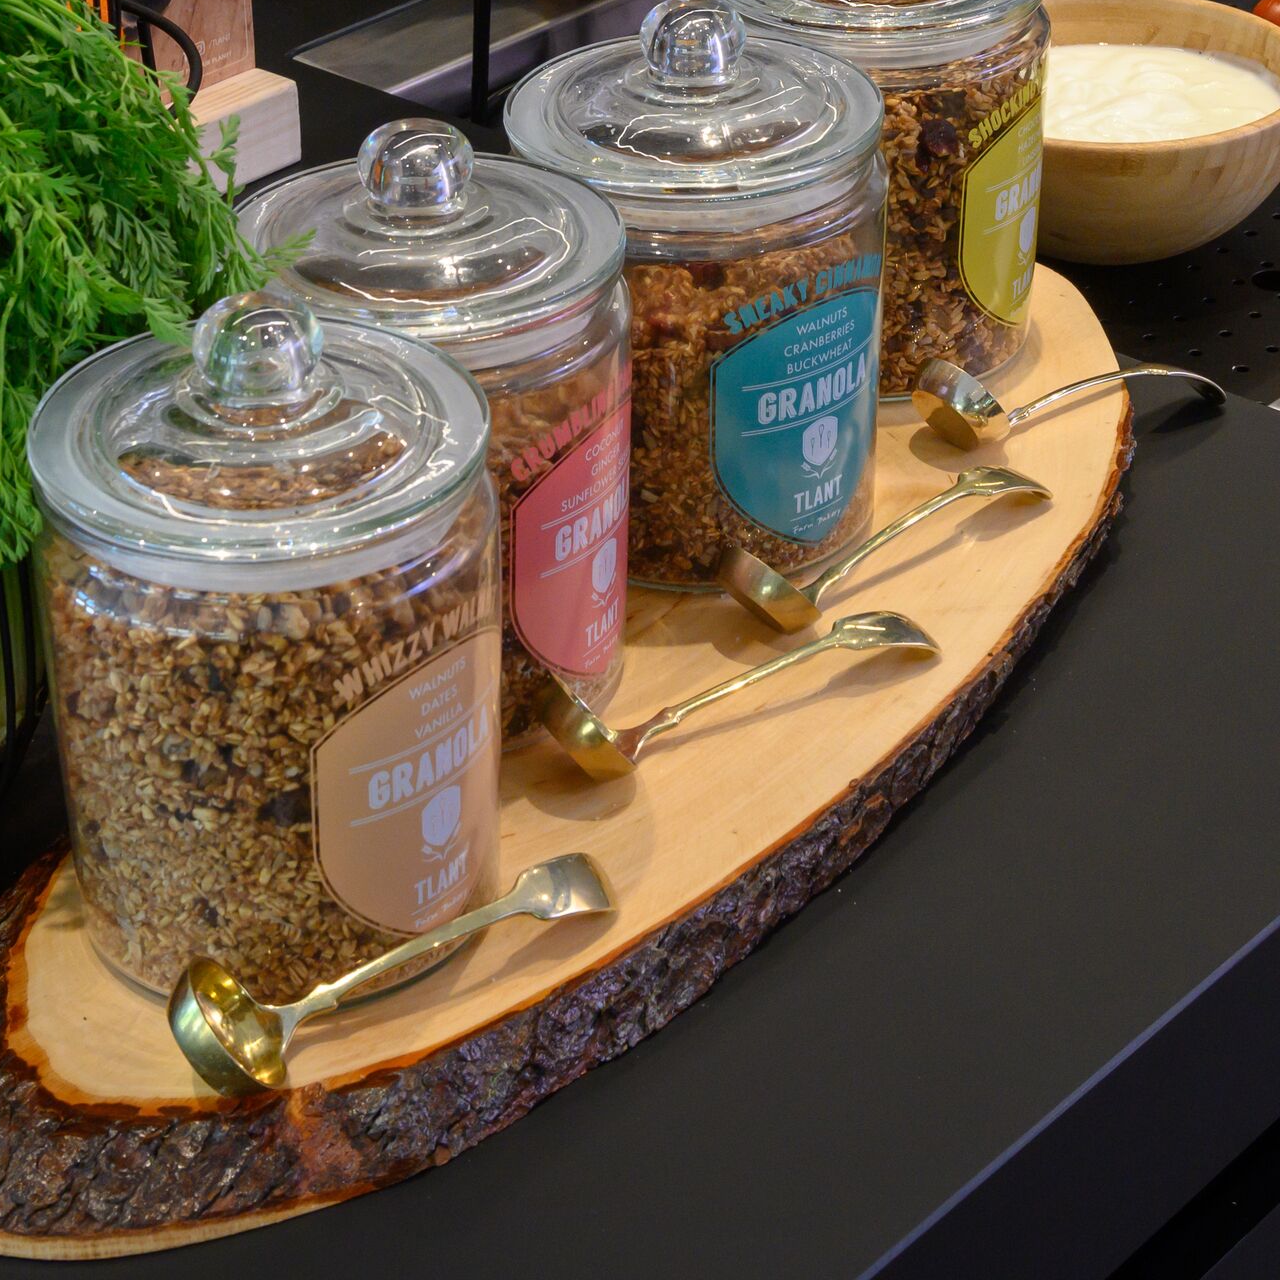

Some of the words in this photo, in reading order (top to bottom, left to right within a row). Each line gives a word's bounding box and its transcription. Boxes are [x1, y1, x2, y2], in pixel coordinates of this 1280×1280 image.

[723, 276, 809, 335] SNEAKY
[796, 306, 848, 336] WALNUTS
[784, 320, 855, 358] CRANBERRIES
[787, 338, 853, 375] BUCKWHEAT
[757, 352, 867, 425] GRANOLA
[561, 468, 618, 513] SUNFLOWER
[794, 474, 843, 514] TLANT
[555, 480, 628, 561] GRANOL
[585, 598, 620, 648] TLANT
[332, 620, 436, 701] WHIZZY
[409, 656, 467, 700] WALNUTS
[414, 702, 464, 739] VANILLA
[421, 684, 458, 717] DATES
[367, 704, 490, 810] GRANOLA
[414, 847, 470, 905] TLANT
